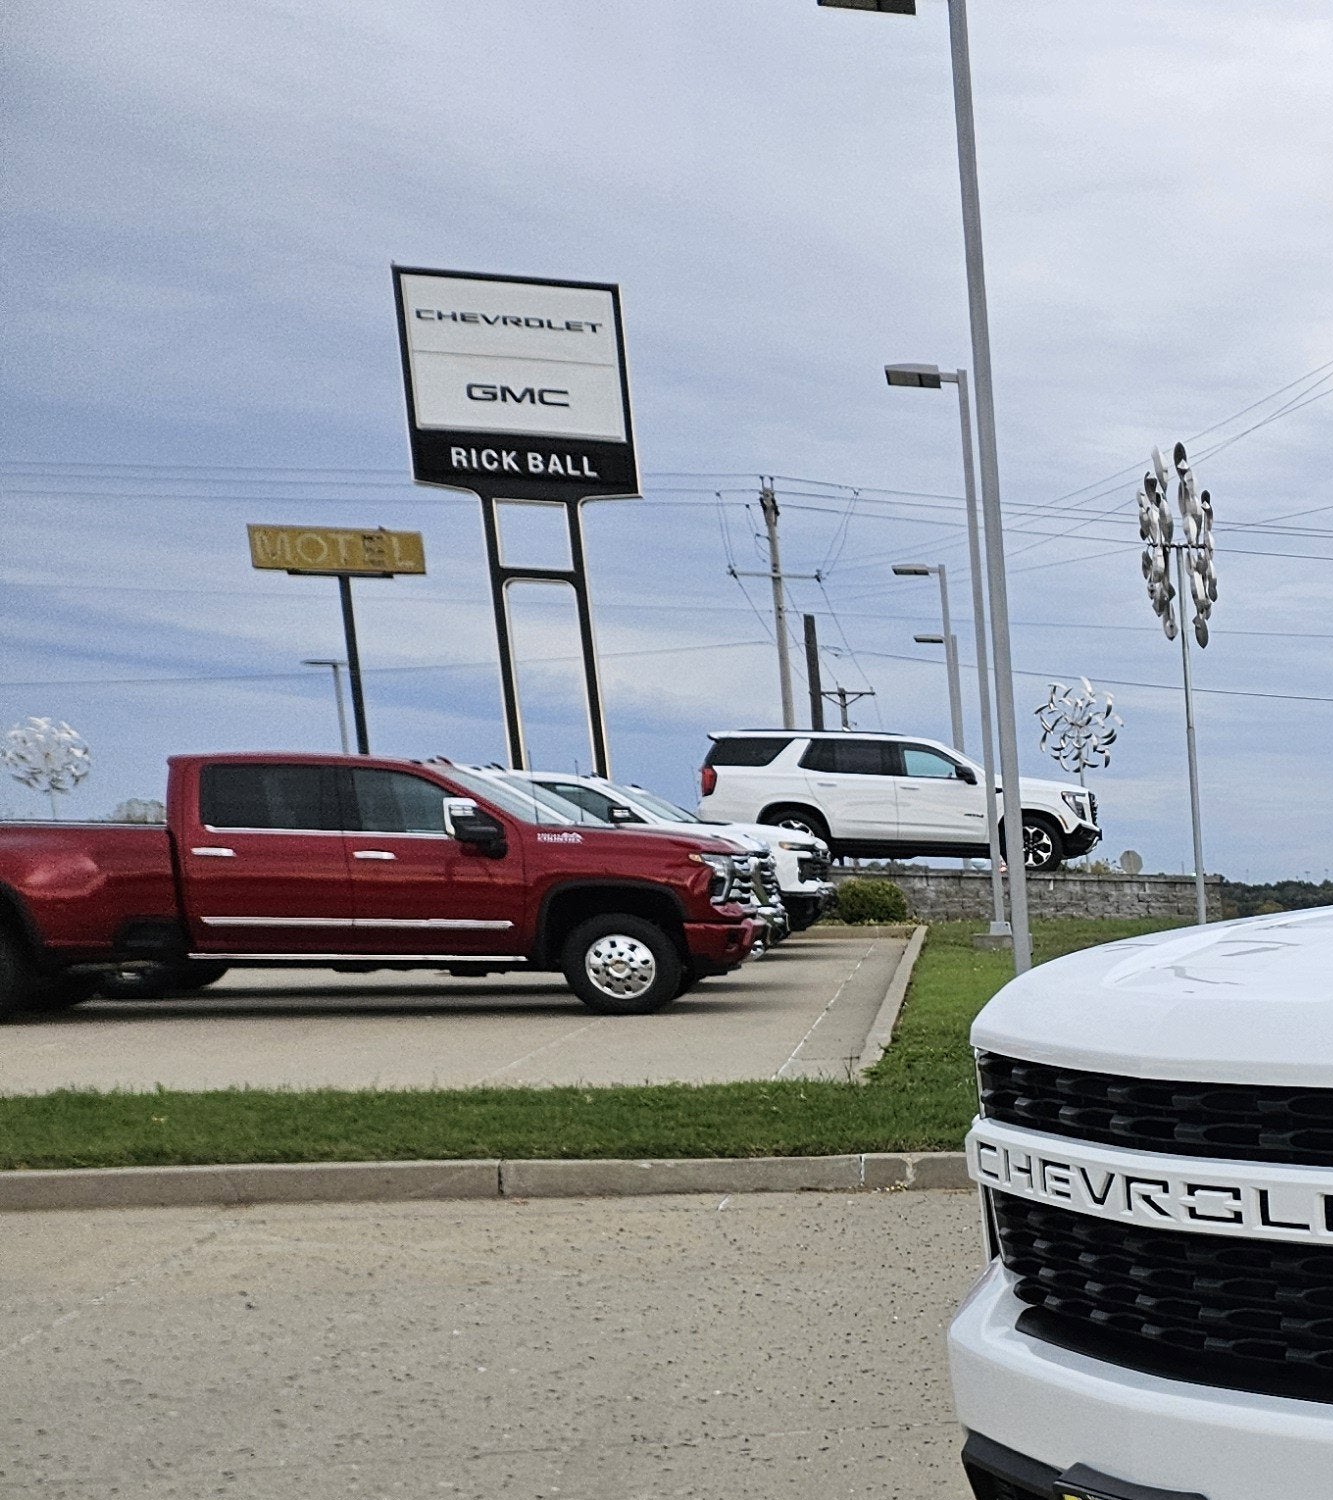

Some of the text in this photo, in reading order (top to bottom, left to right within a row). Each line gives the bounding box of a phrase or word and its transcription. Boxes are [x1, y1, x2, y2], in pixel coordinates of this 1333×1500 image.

[415, 309, 602, 333] CHEVROLET
[466, 383, 570, 407] GMC
[450, 446, 599, 478] RICK BALL
[253, 532, 416, 568] MOTEL
